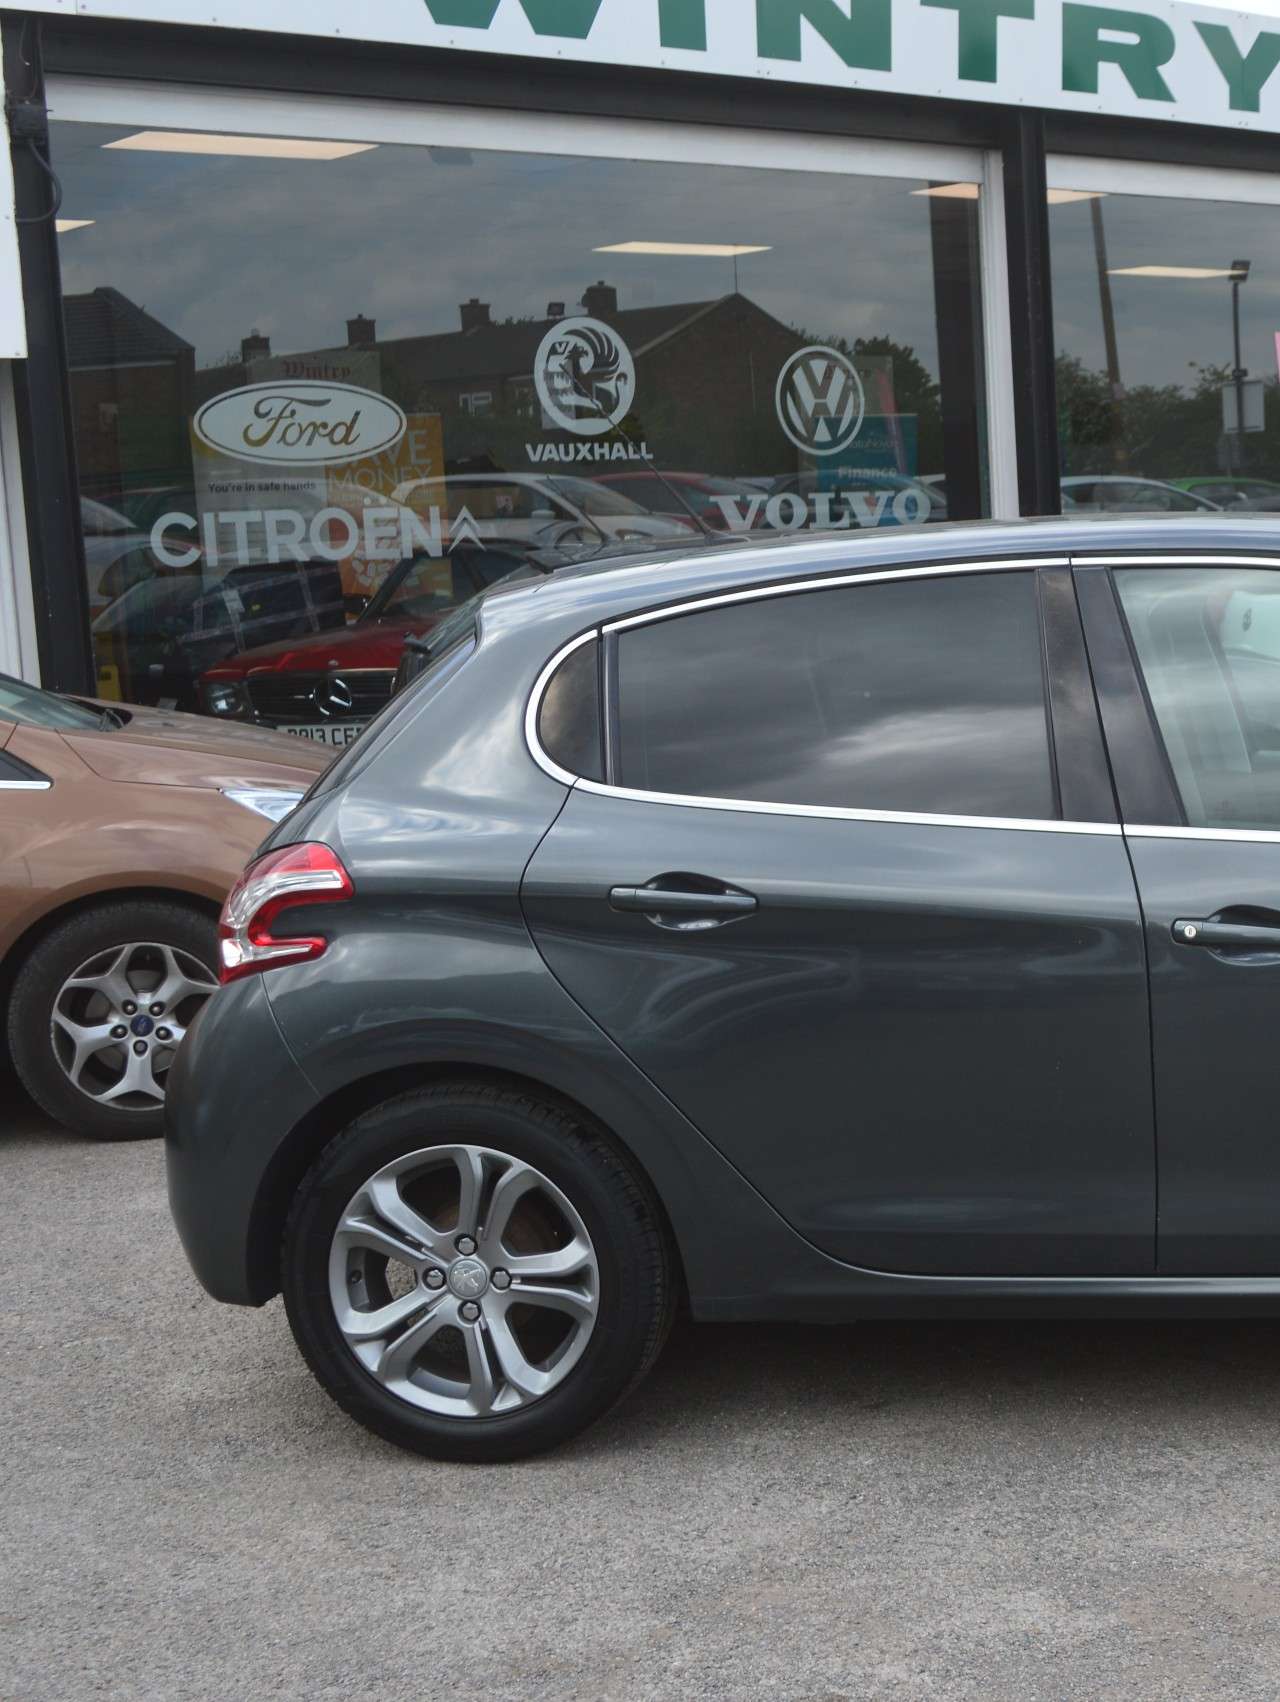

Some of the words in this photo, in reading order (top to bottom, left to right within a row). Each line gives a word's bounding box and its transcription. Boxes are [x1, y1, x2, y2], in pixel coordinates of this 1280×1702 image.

[243, 396, 361, 446] Ford
[525, 441, 654, 463] VAUXHALL
[150, 496, 443, 568] CITROËN
[709, 488, 931, 531] VOLVO
